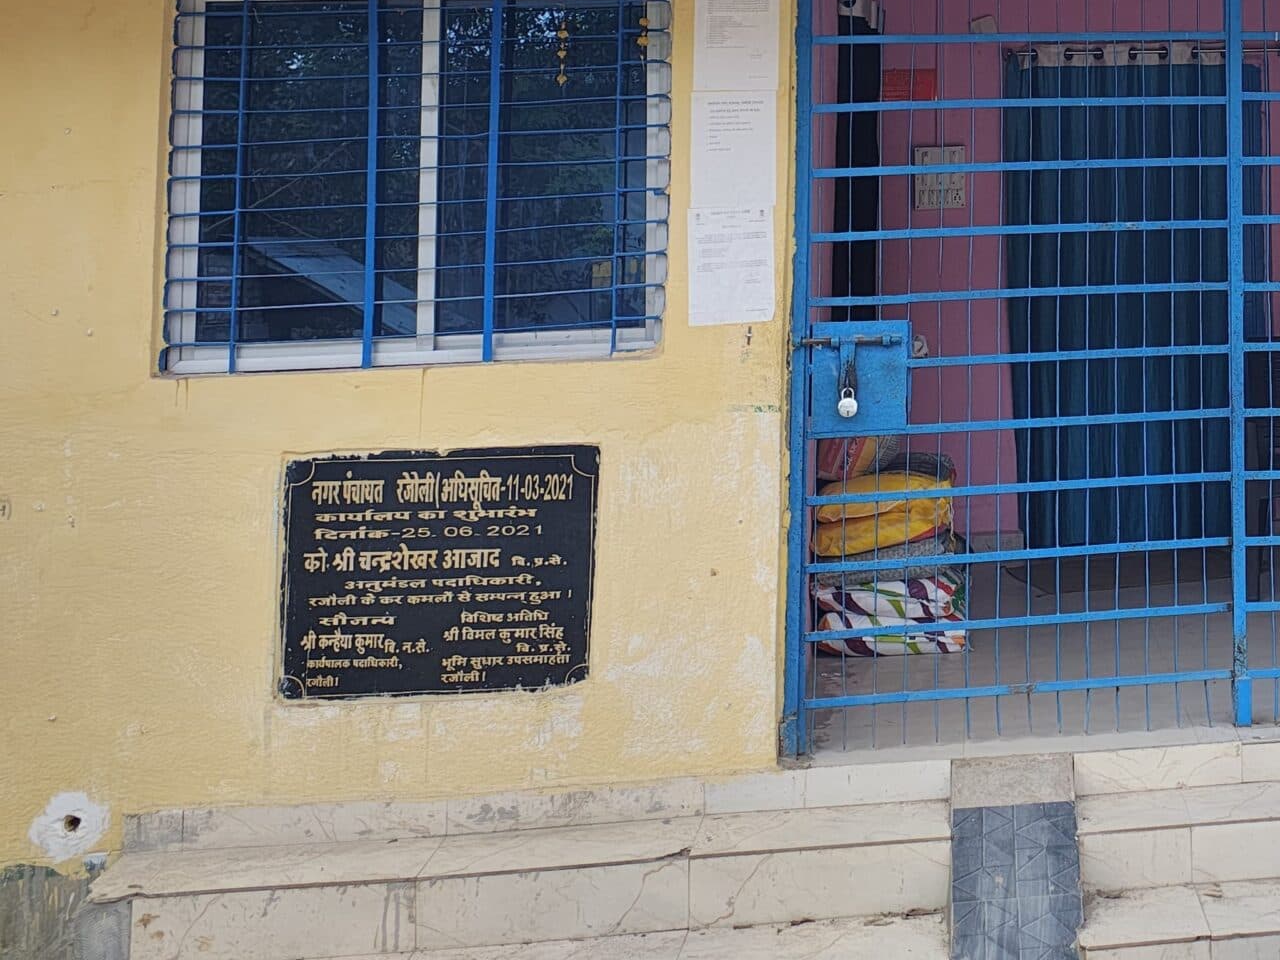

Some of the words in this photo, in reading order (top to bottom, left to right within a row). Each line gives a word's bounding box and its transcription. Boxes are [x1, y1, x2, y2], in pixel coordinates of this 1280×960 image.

[312, 481, 341, 505] नगर
[343, 470, 385, 505] पंचायत
[315, 509, 413, 522] कार्यालय
[417, 510, 448, 520] का
[453, 506, 538, 522] शुभारंभ
[332, 546, 356, 571] श्री
[359, 543, 438, 573] चन्द्रशेखर
[442, 548, 501, 569] आजाद
[344, 576, 427, 592] अनुमंडल
[308, 593, 357, 607] रजौली
[361, 593, 375, 605] के
[380, 595, 404, 605] कर
[407, 592, 453, 605] कमलों
[456, 590, 472, 603] से
[300, 630, 317, 650] श्री
[318, 626, 353, 652] कन्हैया
[355, 634, 384, 654] कुमार
[443, 626, 459, 641] श्री
[462, 627, 496, 640] विमल
[499, 627, 537, 644] कुमार
[539, 622, 564, 639] सिंह
[442, 655, 468, 671] भूमि
[470, 656, 504, 669] सुधार
